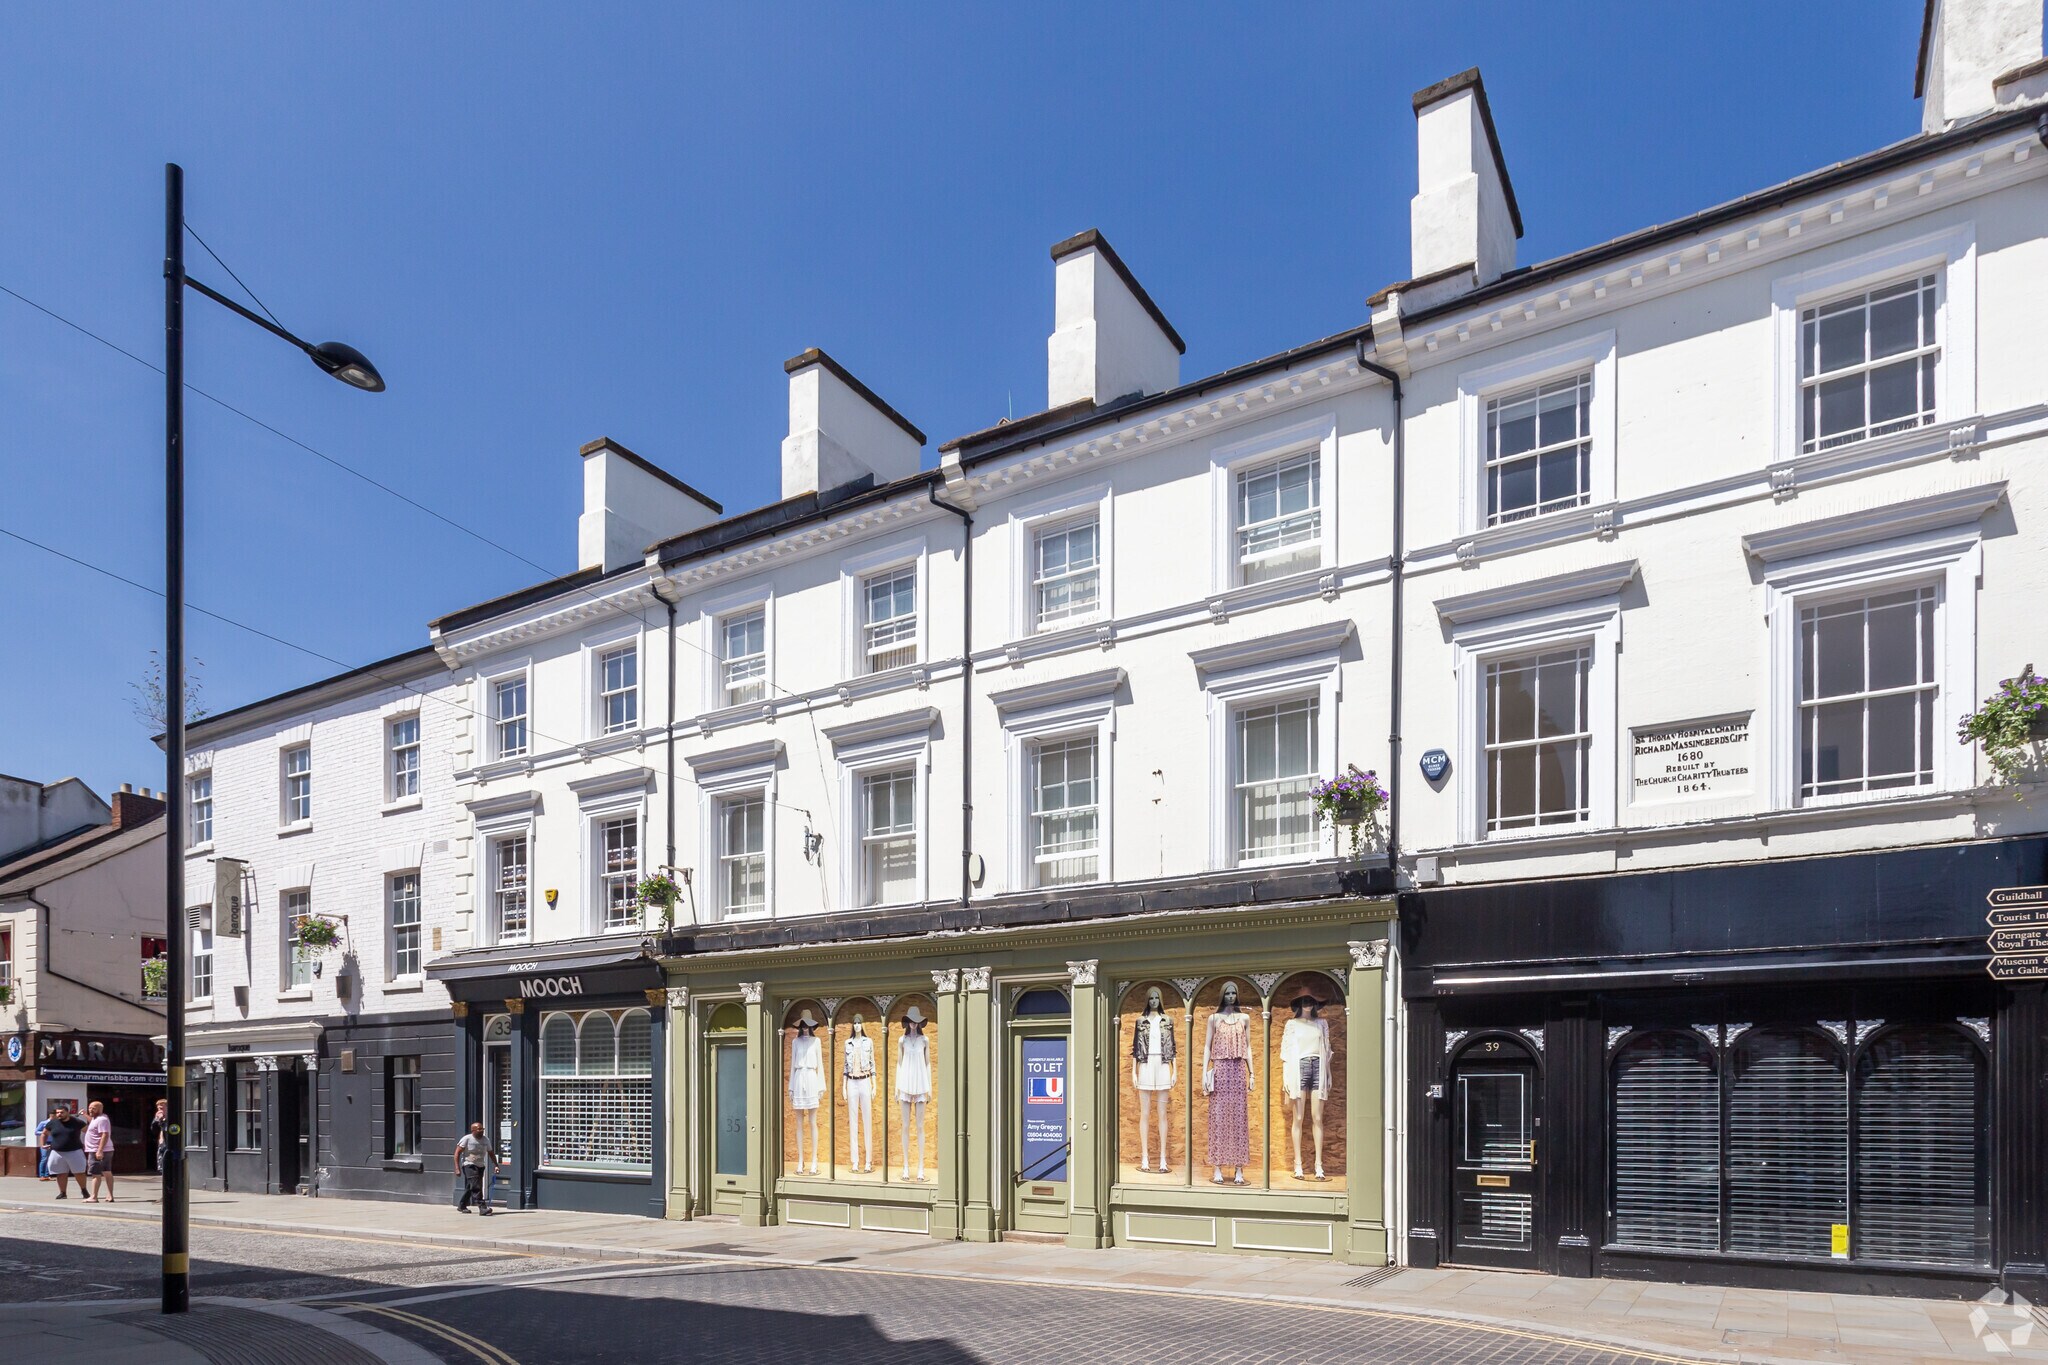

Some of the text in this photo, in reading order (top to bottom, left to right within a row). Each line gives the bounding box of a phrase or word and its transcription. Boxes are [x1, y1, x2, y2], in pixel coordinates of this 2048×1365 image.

[1677, 728, 1714, 738] HOSPITAL
[1715, 724, 1748, 734] CHARITY
[1635, 744, 1670, 755] RICHARD
[1422, 755, 1446, 765] MCM
[1678, 751, 1704, 762] 1680
[1666, 761, 1715, 773] REBUILT BY
[1648, 776, 1677, 785] CHURCH
[1677, 771, 1712, 781] CHARITY
[1996, 892, 2042, 901] Guildhall
[229, 896, 240, 935] baroque
[1997, 913, 2030, 921] Tourist
[1997, 931, 2042, 941] Derngate
[1997, 939, 2024, 950] Royal
[508, 962, 538, 972] MOOCH
[1997, 958, 2038, 966] Museum
[1997, 967, 2014, 975] Art
[520, 976, 582, 997] MOOCH
[495, 1021, 511, 1036] 33
[1485, 1042, 1500, 1052] 39
[1027, 1062, 1063, 1073] TO LET
[53, 1073, 146, 1083] www.marmarisbbq.com
[726, 1118, 741, 1133] 35
[1040, 1123, 1063, 1131] Gregory
